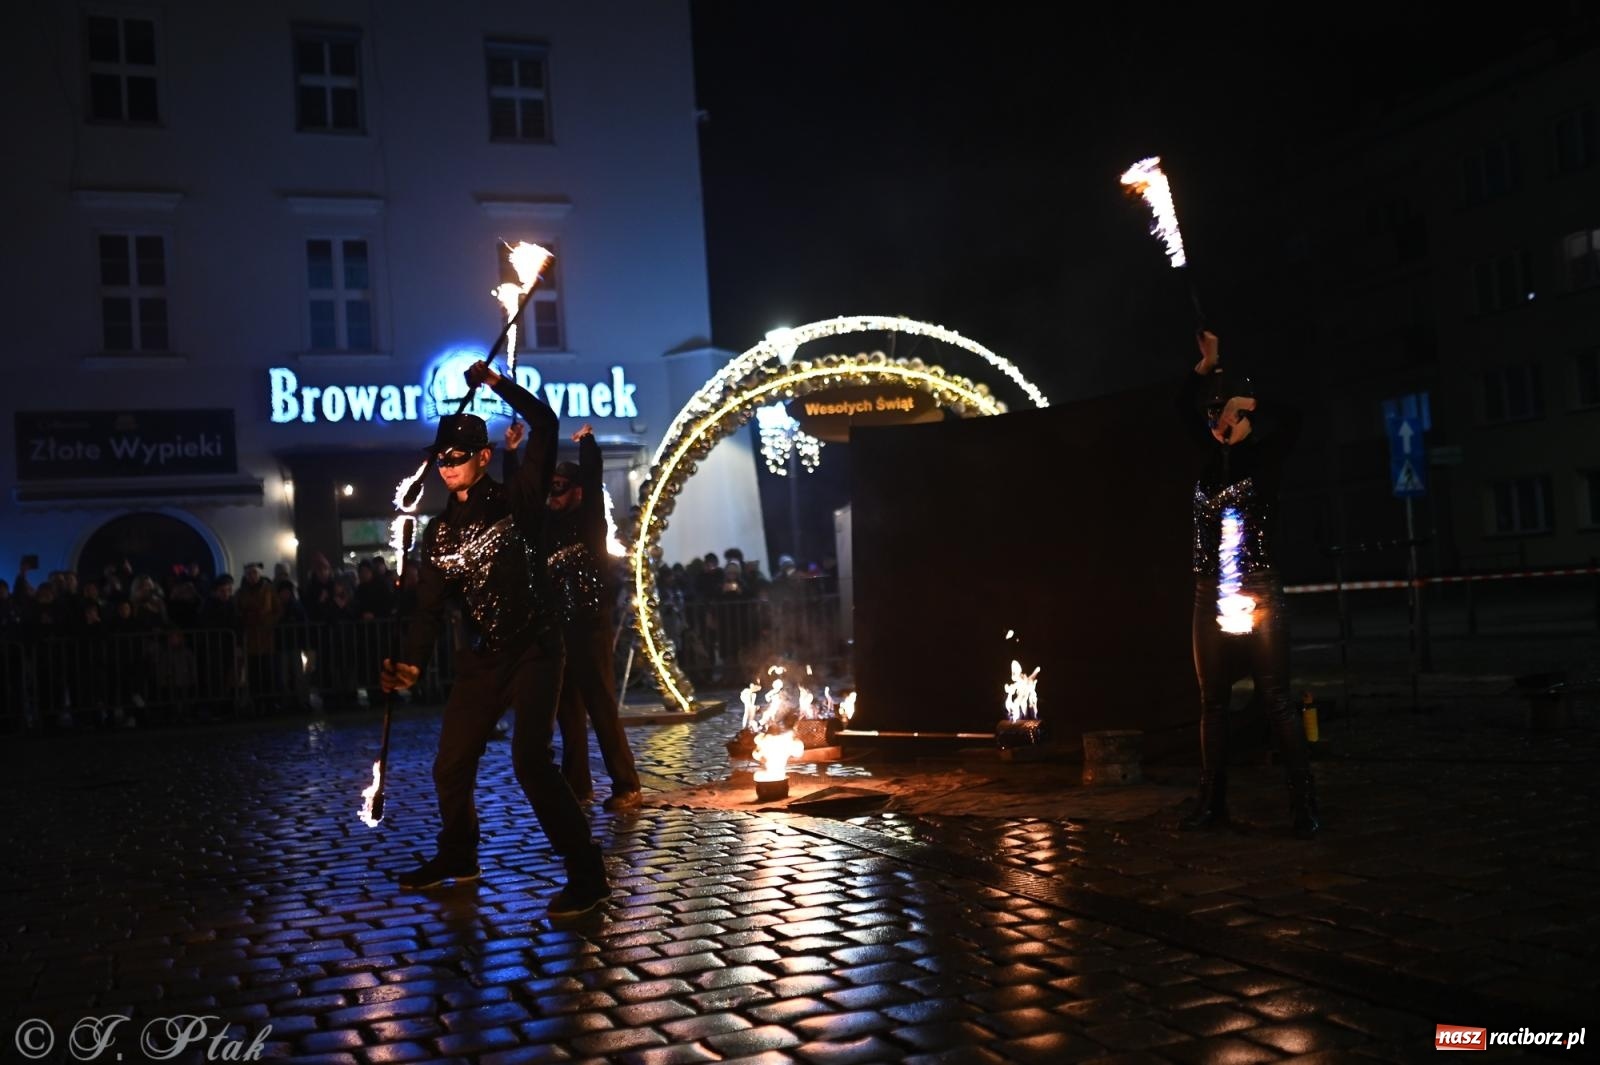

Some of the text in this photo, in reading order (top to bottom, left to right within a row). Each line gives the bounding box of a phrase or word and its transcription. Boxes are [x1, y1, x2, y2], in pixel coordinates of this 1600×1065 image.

[269, 366, 422, 423] Browar
[805, 396, 915, 416] Wesołych Świąt
[29, 432, 223, 465] Złote Wypieki
